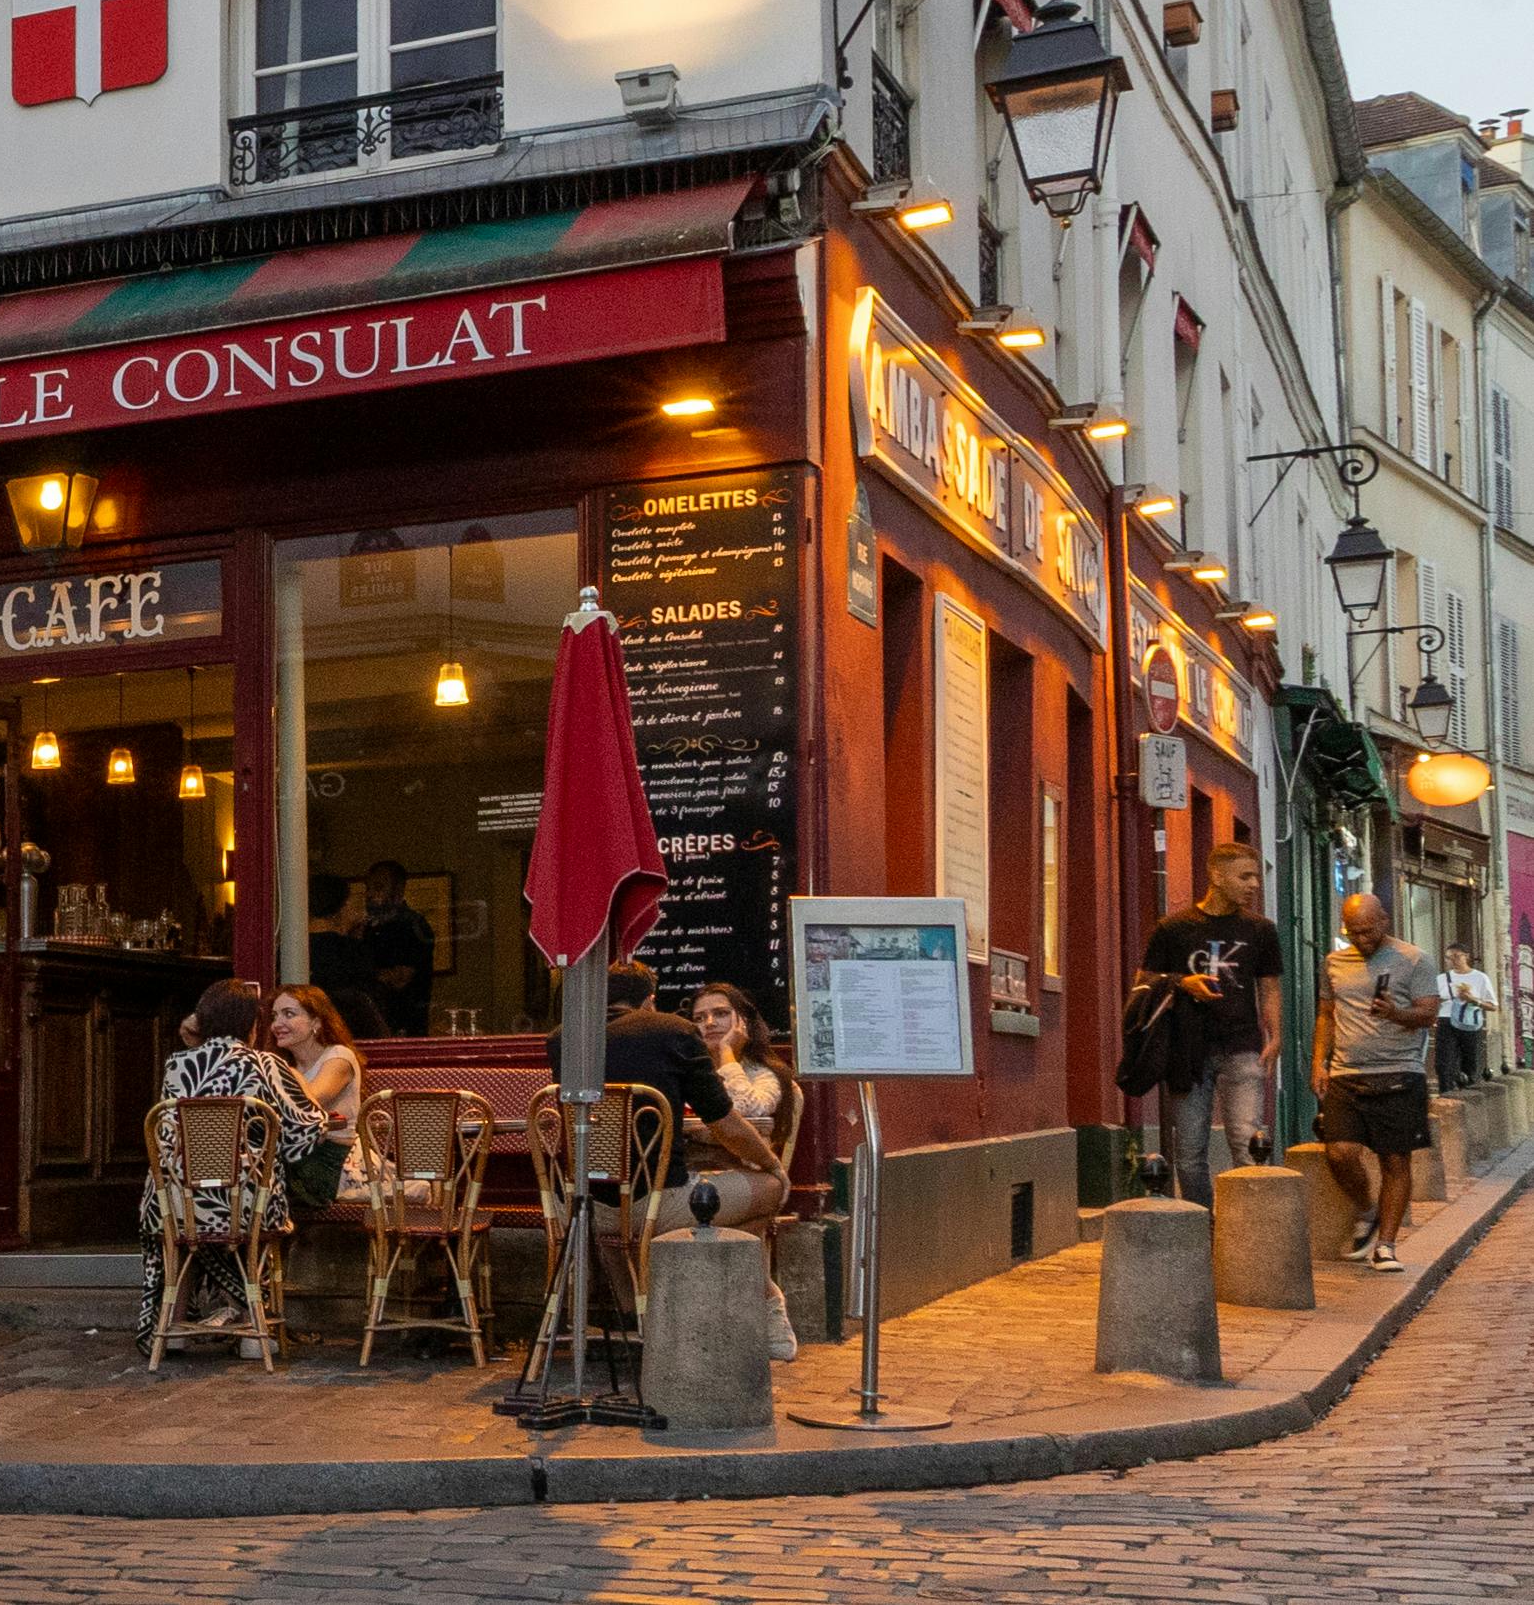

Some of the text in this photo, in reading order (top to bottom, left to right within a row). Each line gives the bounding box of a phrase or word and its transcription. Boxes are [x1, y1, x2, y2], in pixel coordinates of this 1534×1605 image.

[112, 295, 547, 413] CONSULAT
[870, 341, 1008, 532] AMBASSADE
[1024, 481, 1044, 563] DE
[643, 488, 758, 517] OMELETTES
[651, 600, 742, 625] SALADES
[702, 708, 742, 726] jambon
[1155, 740, 1176, 759] SAUF
[767, 781, 779, 792] 15
[655, 797, 781, 820] de 3 fromages 10
[657, 833, 735, 854] CRÊPES
[772, 856, 780, 865] 7
[682, 875, 725, 890] de fraise
